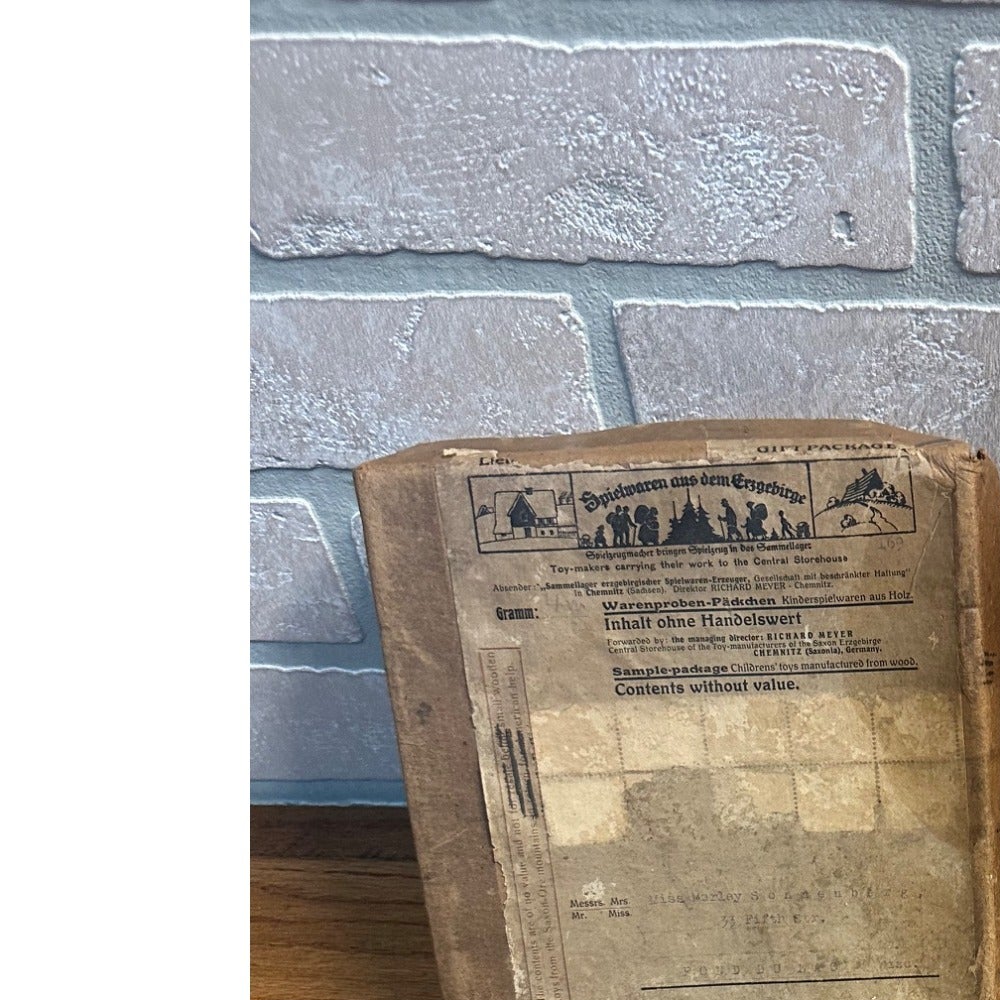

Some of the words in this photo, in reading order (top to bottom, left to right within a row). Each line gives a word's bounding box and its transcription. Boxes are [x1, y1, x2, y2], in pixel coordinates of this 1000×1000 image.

[579, 478, 668, 513] Spielwaren
[670, 475, 698, 488] aus
[701, 473, 731, 487] dem
[732, 473, 806, 504] Erzgebirge
[551, 563, 611, 575] Toy-makers
[615, 562, 656, 573] carrying
[660, 560, 684, 569] their
[689, 559, 714, 569] work
[718, 558, 729, 567] to
[734, 557, 749, 566] the
[753, 556, 789, 566] Central
[794, 554, 848, 565] Storehouse
[586, 587, 625, 597] Chemnitz
[673, 584, 708, 593] Direktor
[711, 583, 752, 592] RICHARD
[755, 581, 786, 590] MEYER
[602, 597, 777, 611] Warenproben-Päckchen
[782, 593, 866, 607] Kinderspielwaren
[869, 593, 886, 601] aus
[496, 606, 540, 621] Gramm:
[604, 616, 652, 631] Inhalt
[657, 615, 696, 629] ohne
[701, 611, 802, 629] Handelswert
[607, 637, 651, 647] Forwarded
[671, 635, 685, 644] the
[688, 634, 726, 645] managing
[767, 631, 814, 641] RICHARD
[818, 630, 854, 639] MEYER
[753, 648, 802, 657] CHEMNITZ
[612, 664, 729, 677] Sample-package
[780, 662, 799, 673] toys
[801, 658, 865, 670] manufactured
[866, 658, 888, 668] from
[889, 656, 919, 667] wood.
[615, 681, 685, 696] Contents
[690, 679, 749, 694] without
[753, 678, 800, 692] value.
